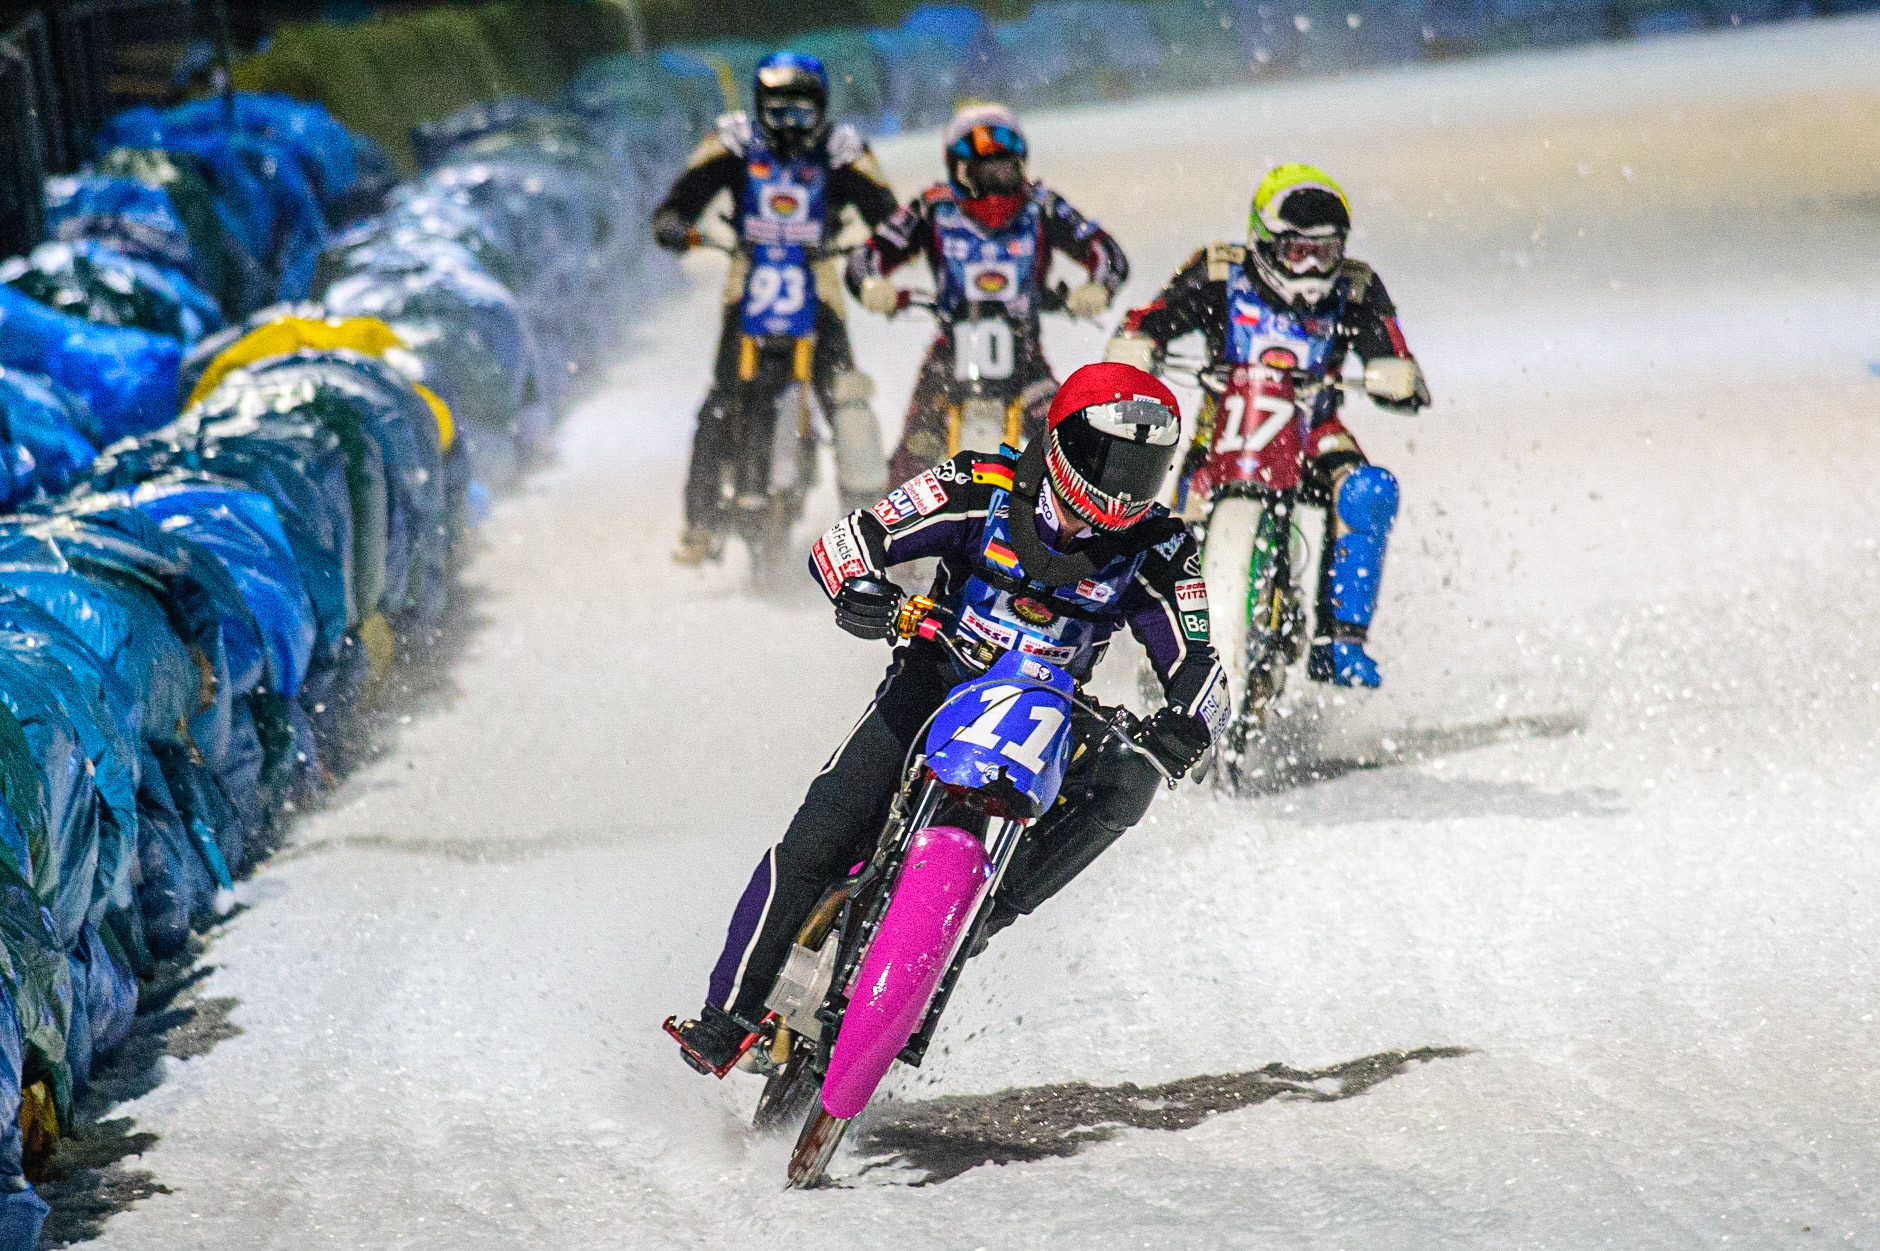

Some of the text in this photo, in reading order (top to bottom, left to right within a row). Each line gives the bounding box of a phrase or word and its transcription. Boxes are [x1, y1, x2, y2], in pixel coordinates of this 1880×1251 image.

[746, 266, 805, 315] 93
[953, 319, 1014, 380] 10
[1215, 395, 1294, 454] 17
[1184, 614, 1207, 632] Ba
[951, 685, 1065, 775] 11
